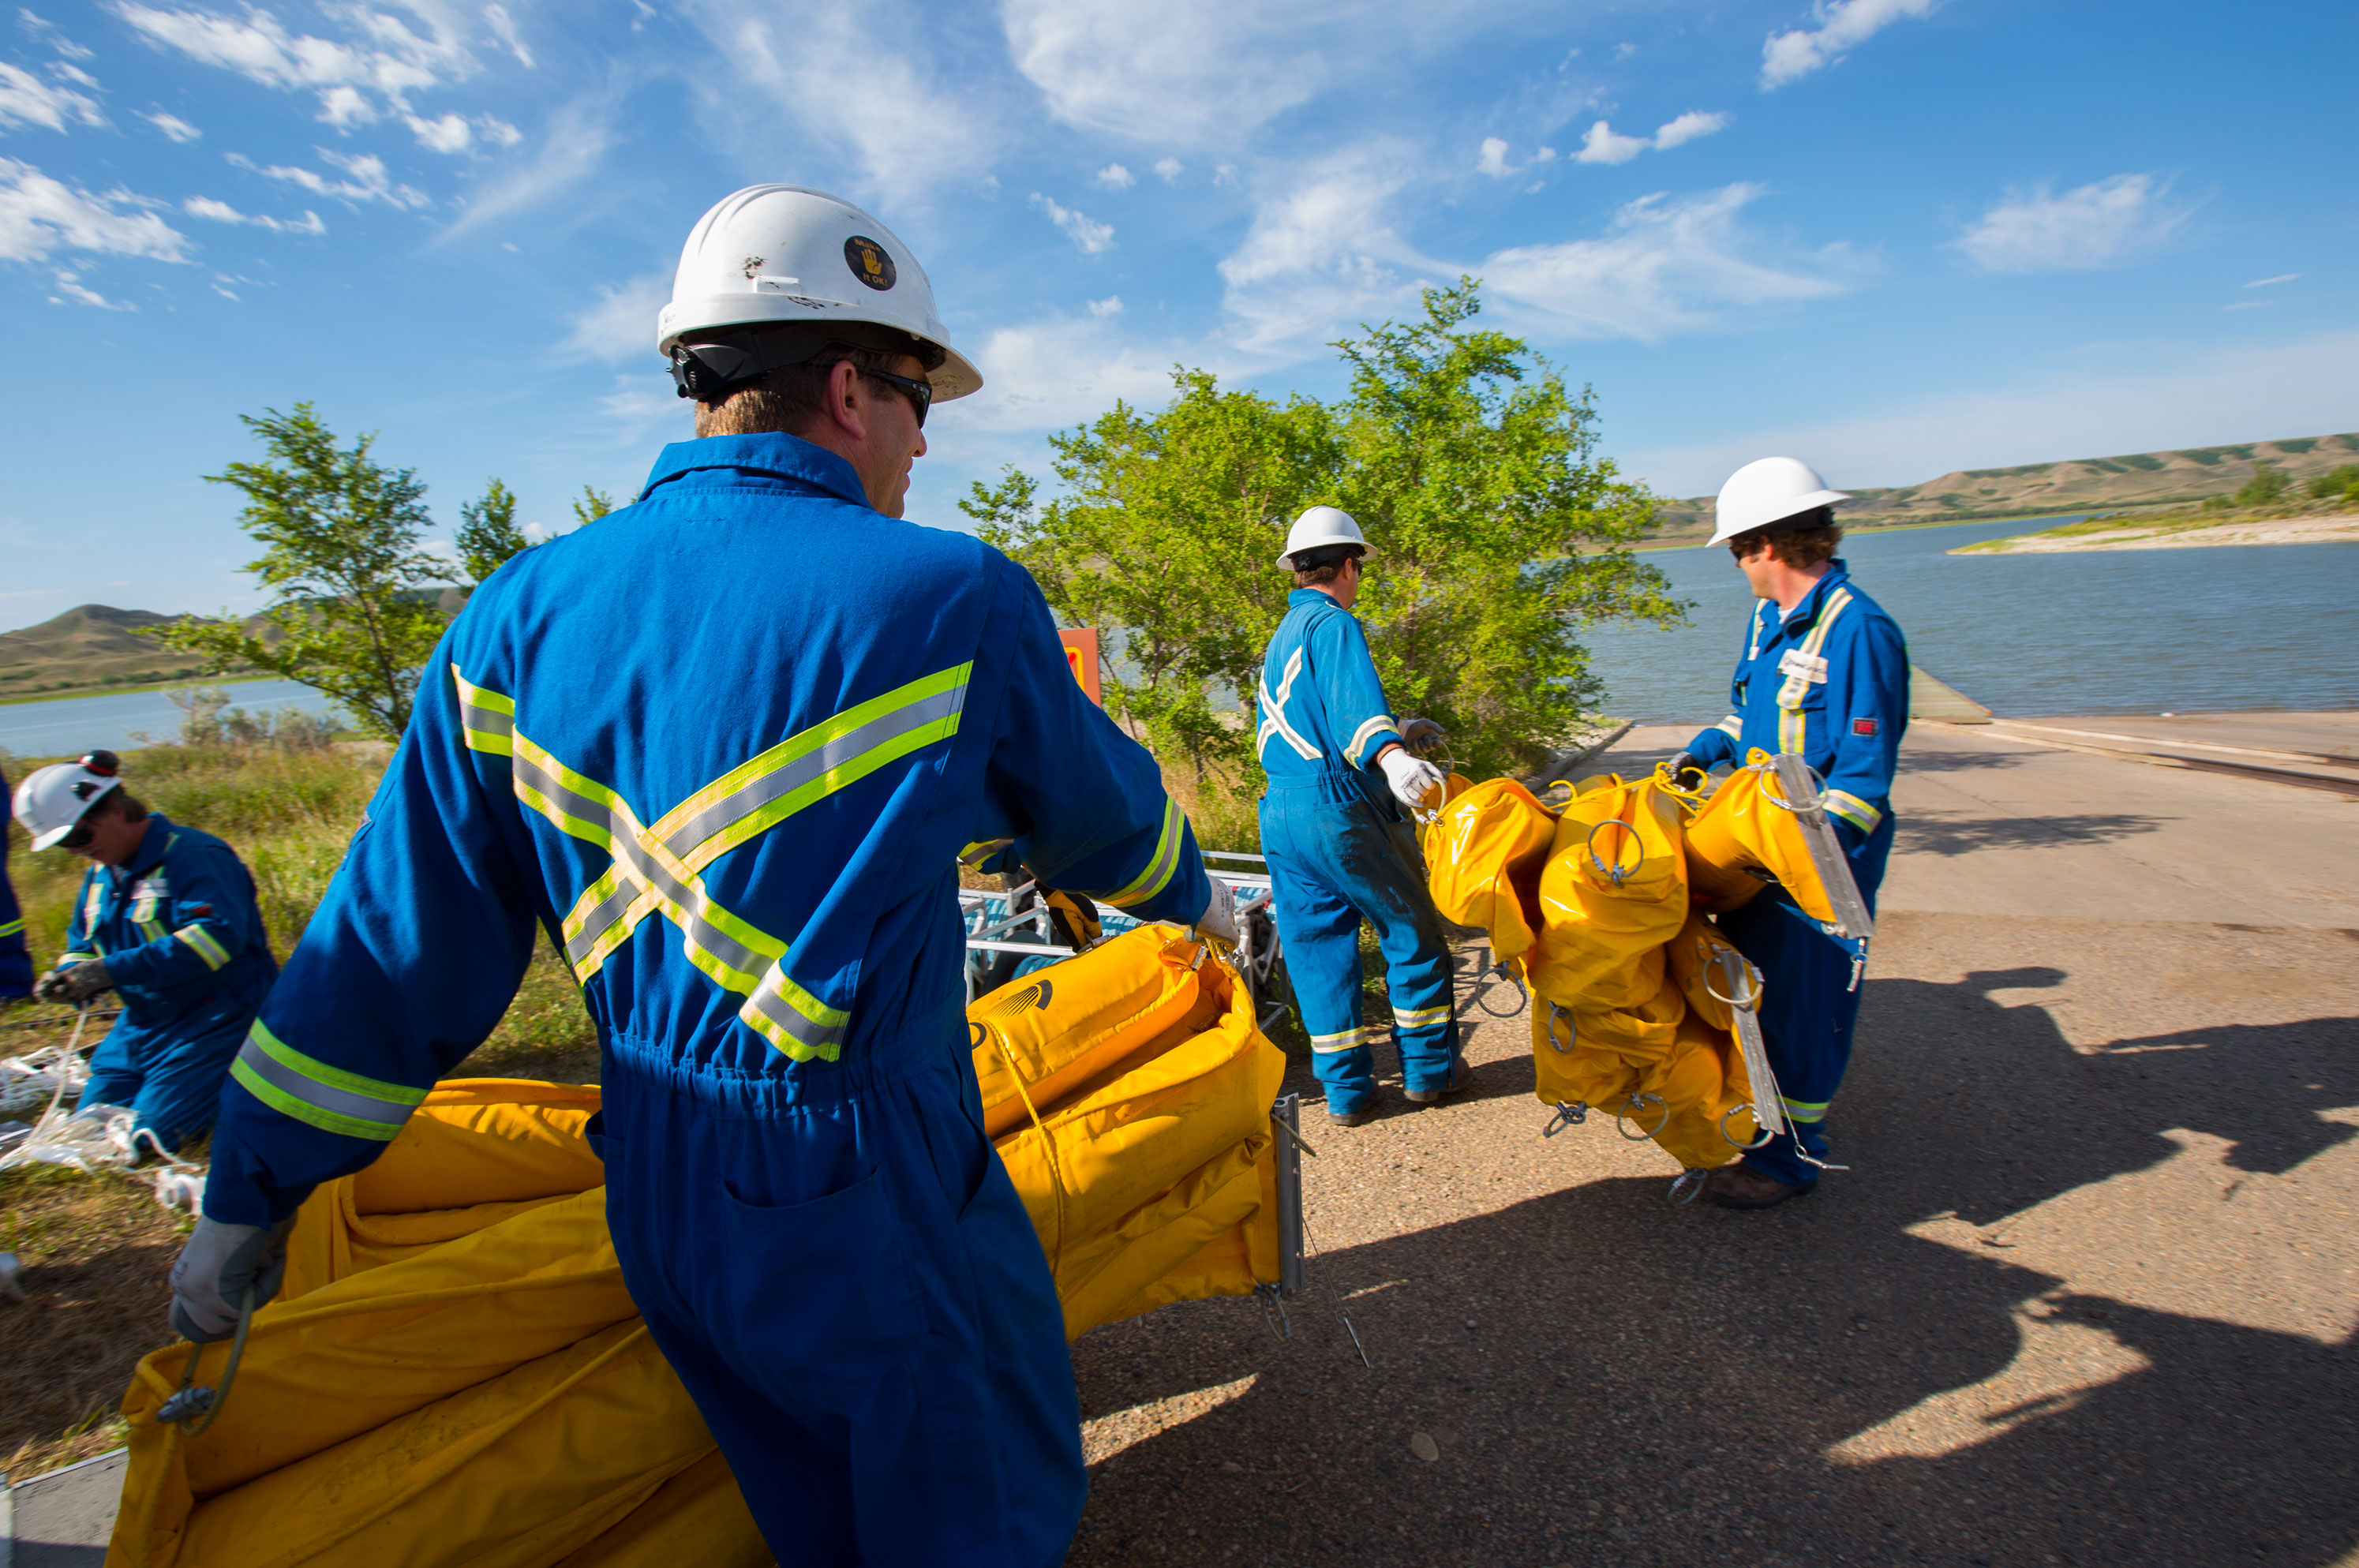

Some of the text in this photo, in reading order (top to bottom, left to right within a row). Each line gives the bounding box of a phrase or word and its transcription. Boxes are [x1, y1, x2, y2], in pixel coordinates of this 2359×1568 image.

[854, 238, 882, 252] Make
[863, 273, 888, 286] It OK!
